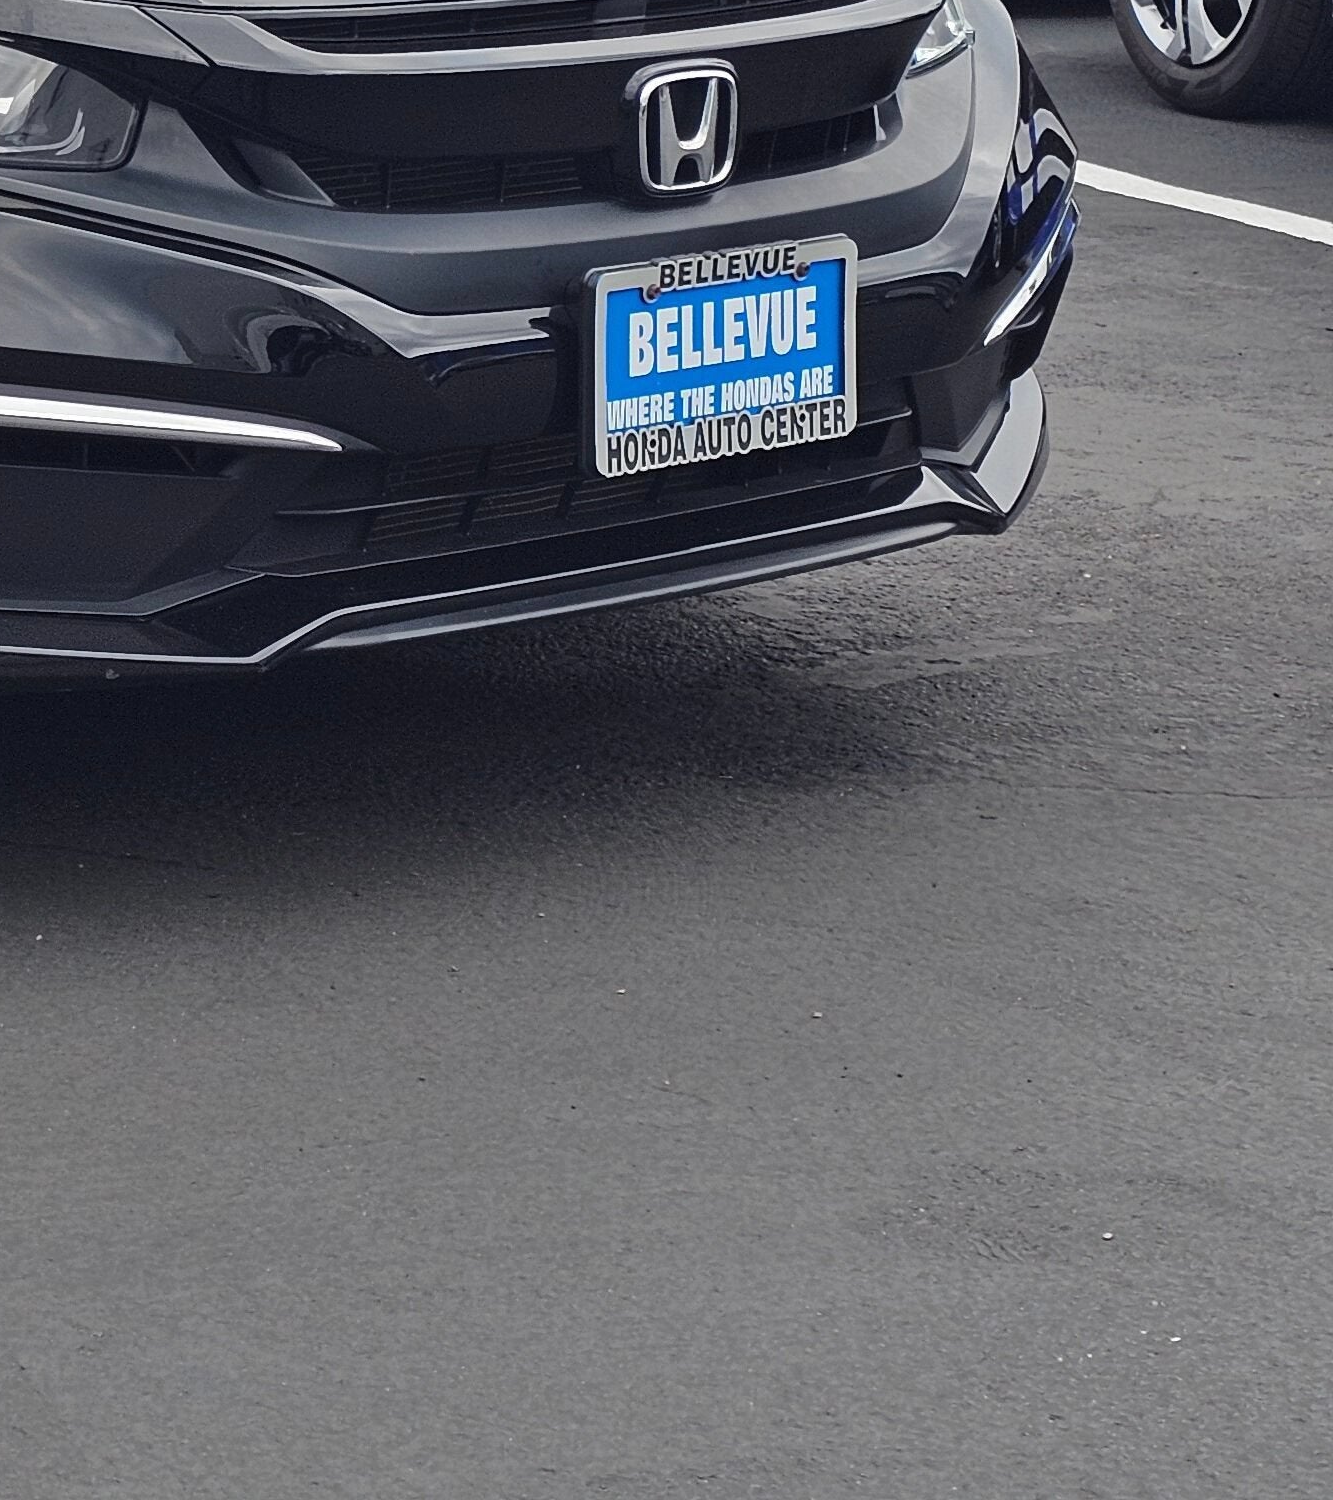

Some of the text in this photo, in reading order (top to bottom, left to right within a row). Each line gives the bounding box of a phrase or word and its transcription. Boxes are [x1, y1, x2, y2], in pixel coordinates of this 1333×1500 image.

[659, 245, 797, 289] BELLEVUE
[629, 285, 817, 377] BELLEVUE
[607, 364, 834, 430] WHERE THE HONDAS ARE
[607, 398, 847, 474] HONDA AUTO CENTER
